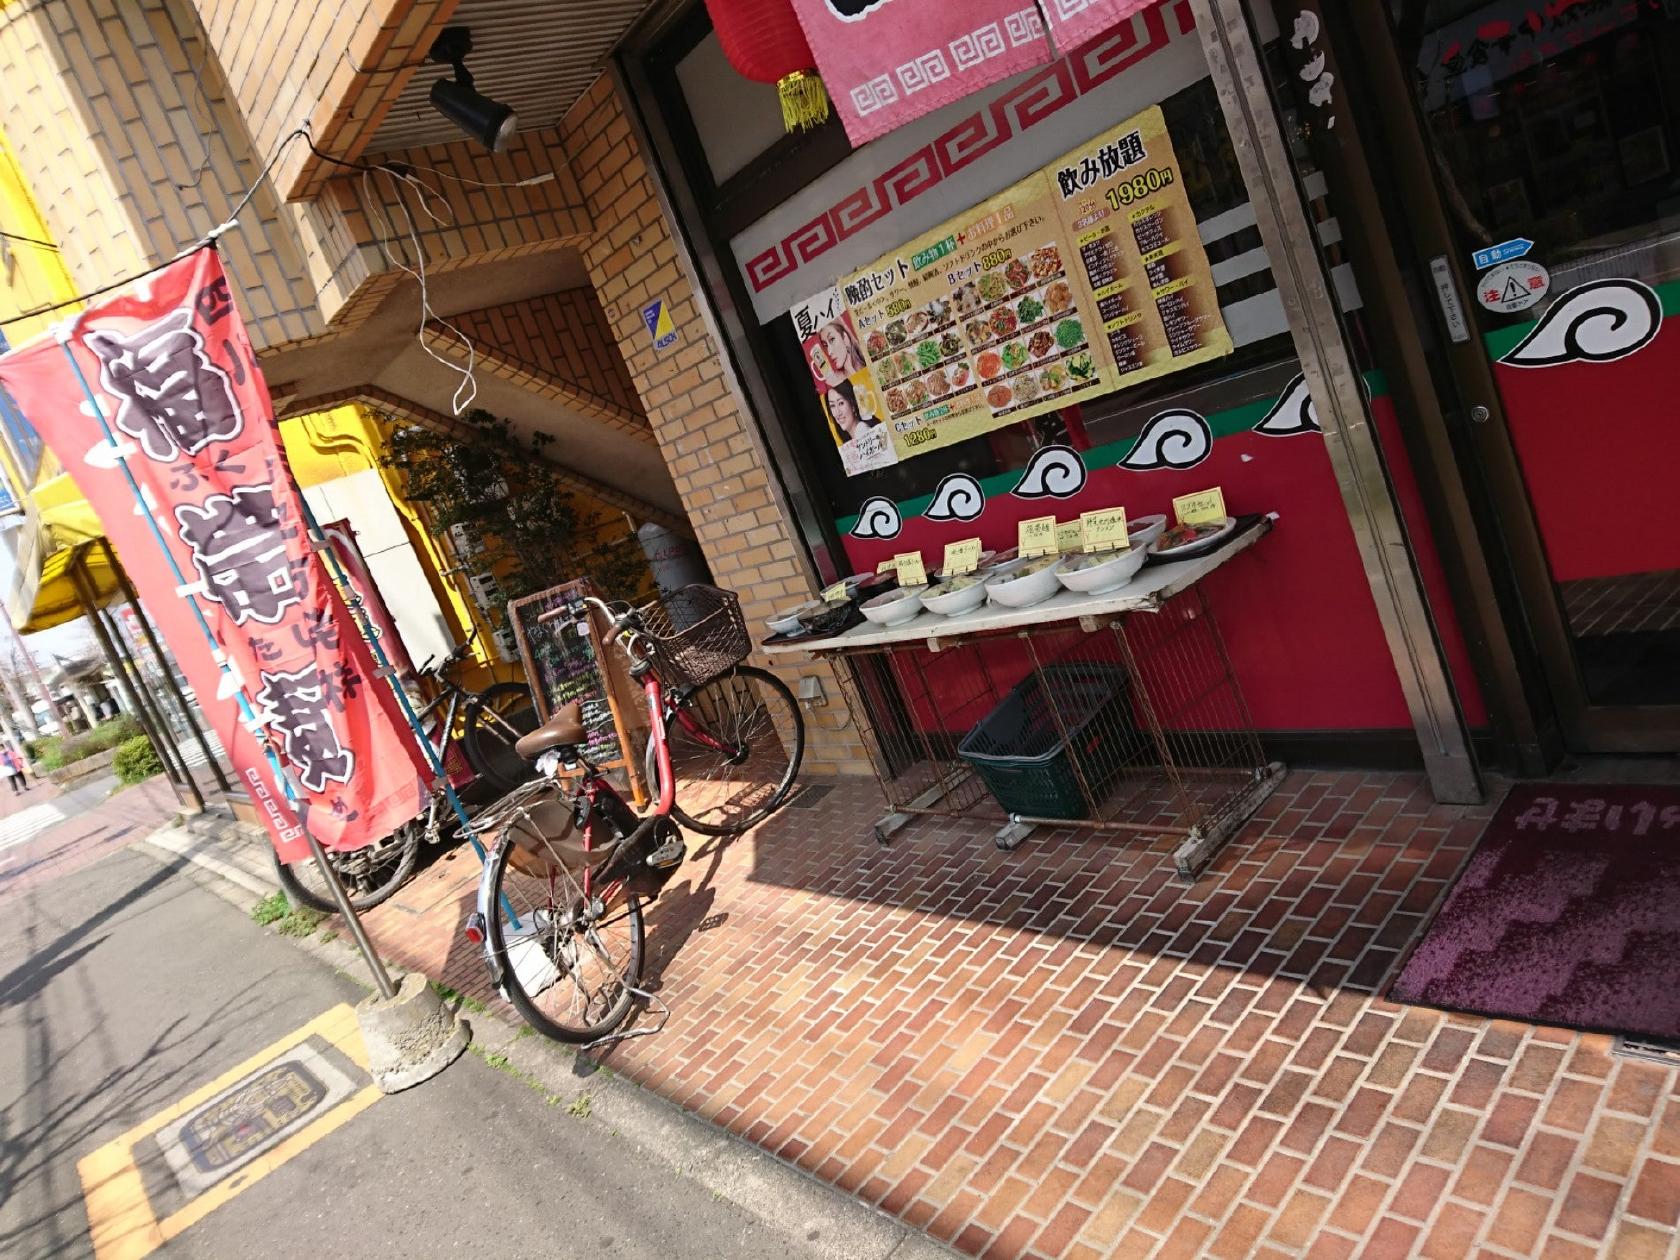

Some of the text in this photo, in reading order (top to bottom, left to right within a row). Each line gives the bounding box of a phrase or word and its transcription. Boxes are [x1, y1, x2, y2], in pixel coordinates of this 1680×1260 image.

[1056, 130, 1145, 198] 飲み放題
[1105, 161, 1173, 212] 1980円
[843, 257, 910, 305] 晩酌セット
[947, 245, 1013, 285] Bセット 880円
[795, 298, 834, 343] 夏ハイ
[857, 296, 912, 329] Aセット 580円
[903, 426, 937, 447] 1280円
